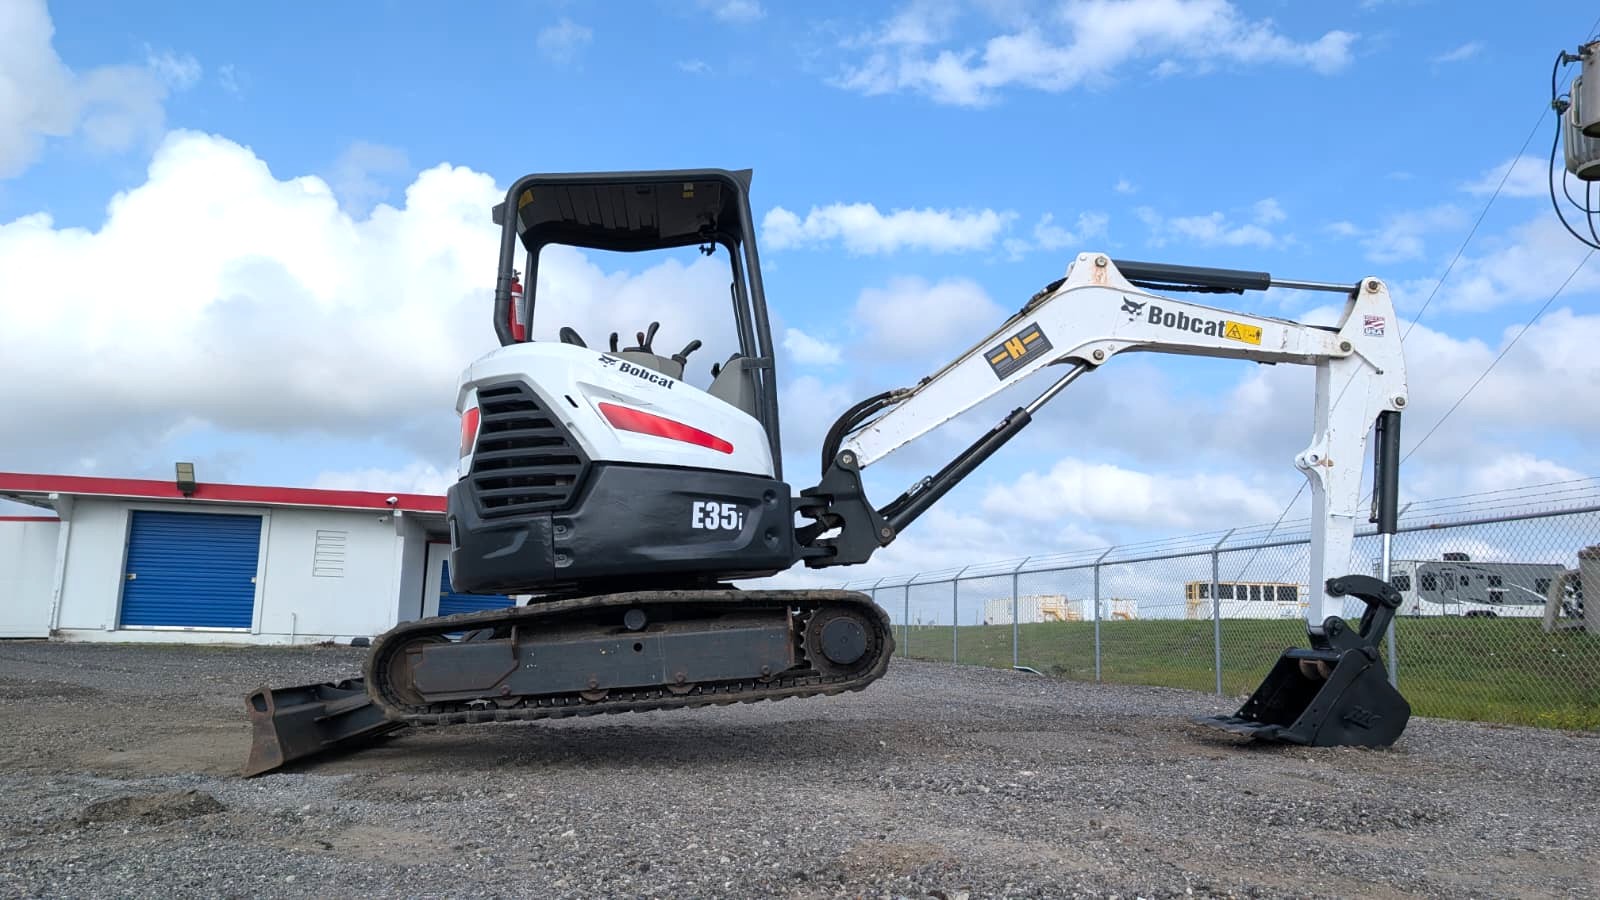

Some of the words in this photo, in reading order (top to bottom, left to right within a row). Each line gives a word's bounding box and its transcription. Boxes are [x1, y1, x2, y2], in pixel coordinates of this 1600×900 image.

[1147, 305, 1225, 338] Bobcat
[619, 362, 674, 390] Bobcat
[692, 501, 743, 530] E35i
